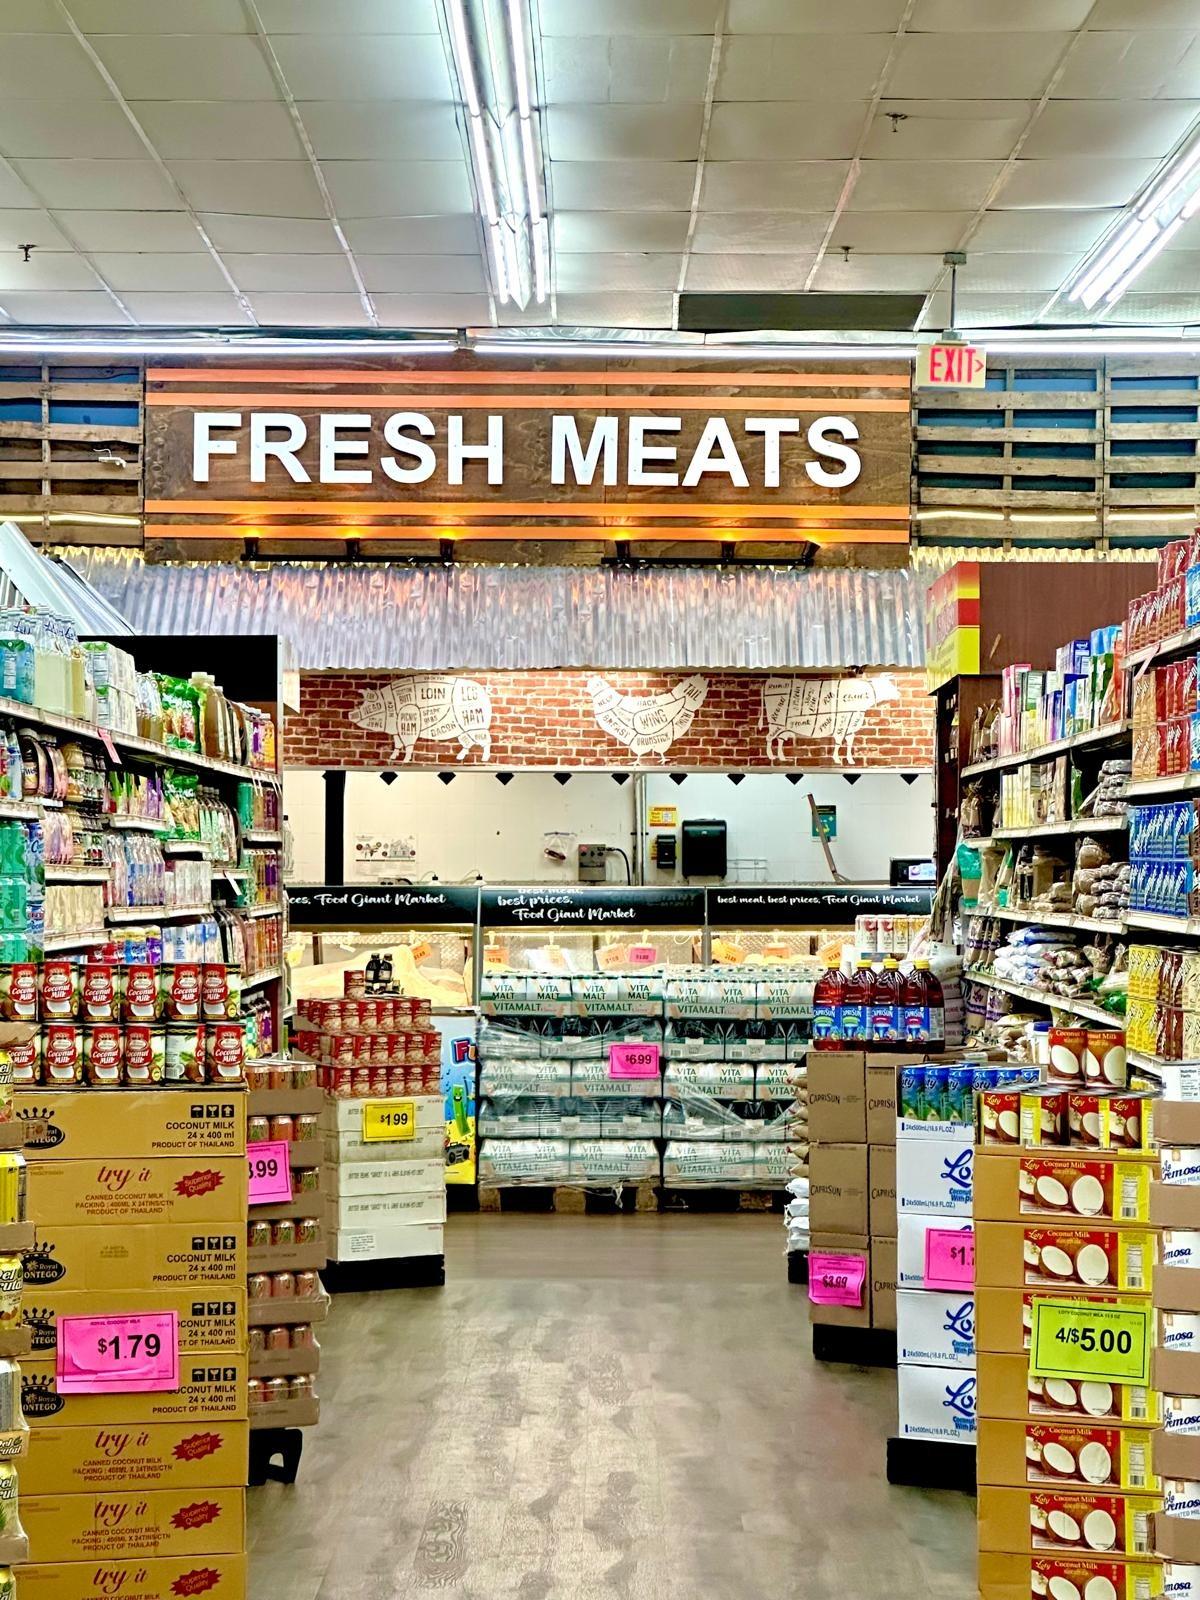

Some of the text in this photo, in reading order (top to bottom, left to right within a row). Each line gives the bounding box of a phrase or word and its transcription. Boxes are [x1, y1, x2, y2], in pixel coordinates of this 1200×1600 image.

[930, 347, 976, 383] EXIT
[193, 412, 862, 488] FRESH MEATS
[421, 688, 445, 700] LOIN
[683, 683, 702, 701] TAIL
[462, 708, 484, 726] HAM
[639, 708, 668, 729] WING
[401, 722, 417, 732] HAM
[430, 721, 457, 738] BACON
[602, 715, 631, 738] BREAST
[288, 892, 447, 907] ces, Food Giant Market
[497, 895, 574, 908] best prices,
[717, 894, 737, 904] best
[768, 894, 788, 904] best
[790, 895, 822, 907] prices,
[822, 894, 849, 905] Food
[850, 894, 881, 907] Giant
[883, 894, 921, 905] Market
[512, 907, 636, 922] Food Giant Market
[12, 987, 36, 995] Coconut
[43, 984, 70, 993] Coconut
[85, 988, 111, 997] Coconut
[128, 988, 154, 996] Coconut
[173, 987, 198, 995] Coconut
[494, 984, 514, 993] VITA
[539, 984, 559, 993] VITA
[585, 984, 605, 993] VITA
[630, 984, 650, 992] VITA
[679, 987, 697, 996] VITA
[723, 988, 743, 996] VITA
[770, 988, 789, 996] VITA
[19, 993, 33, 1001] Milk
[52, 991, 67, 999] Milk
[181, 993, 195, 1001] Milk
[492, 992, 515, 1001] MALT
[537, 992, 561, 1001] MALT
[583, 992, 607, 1001] MALT
[628, 991, 652, 1000] MALT
[677, 995, 699, 1004] MALT
[721, 995, 744, 1004] MALT
[768, 995, 790, 1004] MALT
[493, 1001, 541, 1012] VITAMALT
[584, 1002, 632, 1012] VITAMALT
[677, 1004, 725, 1015] VITAMALT
[8, 1049, 33, 1058] Coconut
[47, 1049, 74, 1058] Coconut
[92, 1049, 118, 1058] Coconut
[14, 1055, 29, 1063] Milk
[55, 1055, 70, 1064] Milk
[100, 1056, 115, 1064] Milk
[584, 1083, 632, 1093] VITAMALT
[676, 1084, 724, 1095] VITAMALT
[166, 1121, 235, 1130] COCONUT MILK
[187, 1131, 198, 1139] 24
[207, 1131, 222, 1139] 400
[200, 1140, 235, 1148] THAILAND
[1043, 1160, 1070, 1168] Coconut
[248, 1158, 278, 1180] 3.99
[940, 1149, 973, 1189] Lo
[97, 1165, 152, 1192] try it
[1047, 1230, 1072, 1238] Coconut
[1074, 1231, 1090, 1239] Milk
[167, 1254, 236, 1262] COCONUT MILK
[188, 1264, 199, 1272] 24
[208, 1264, 223, 1272] 400
[153, 1274, 187, 1282] PRODUCT
[943, 1301, 975, 1341] Lo
[1056, 1327, 1132, 1354] 4/$5.00
[1164, 1331, 1194, 1342] mosa
[98, 1333, 161, 1360] $1.79
[943, 1377, 976, 1417] Lo
[23, 1403, 56, 1411] ONTEGO
[1049, 1427, 1075, 1435] Coconut
[1076, 1427, 1093, 1436] Milk
[95, 1430, 150, 1457] try it
[1054, 1494, 1079, 1502] Coconut
